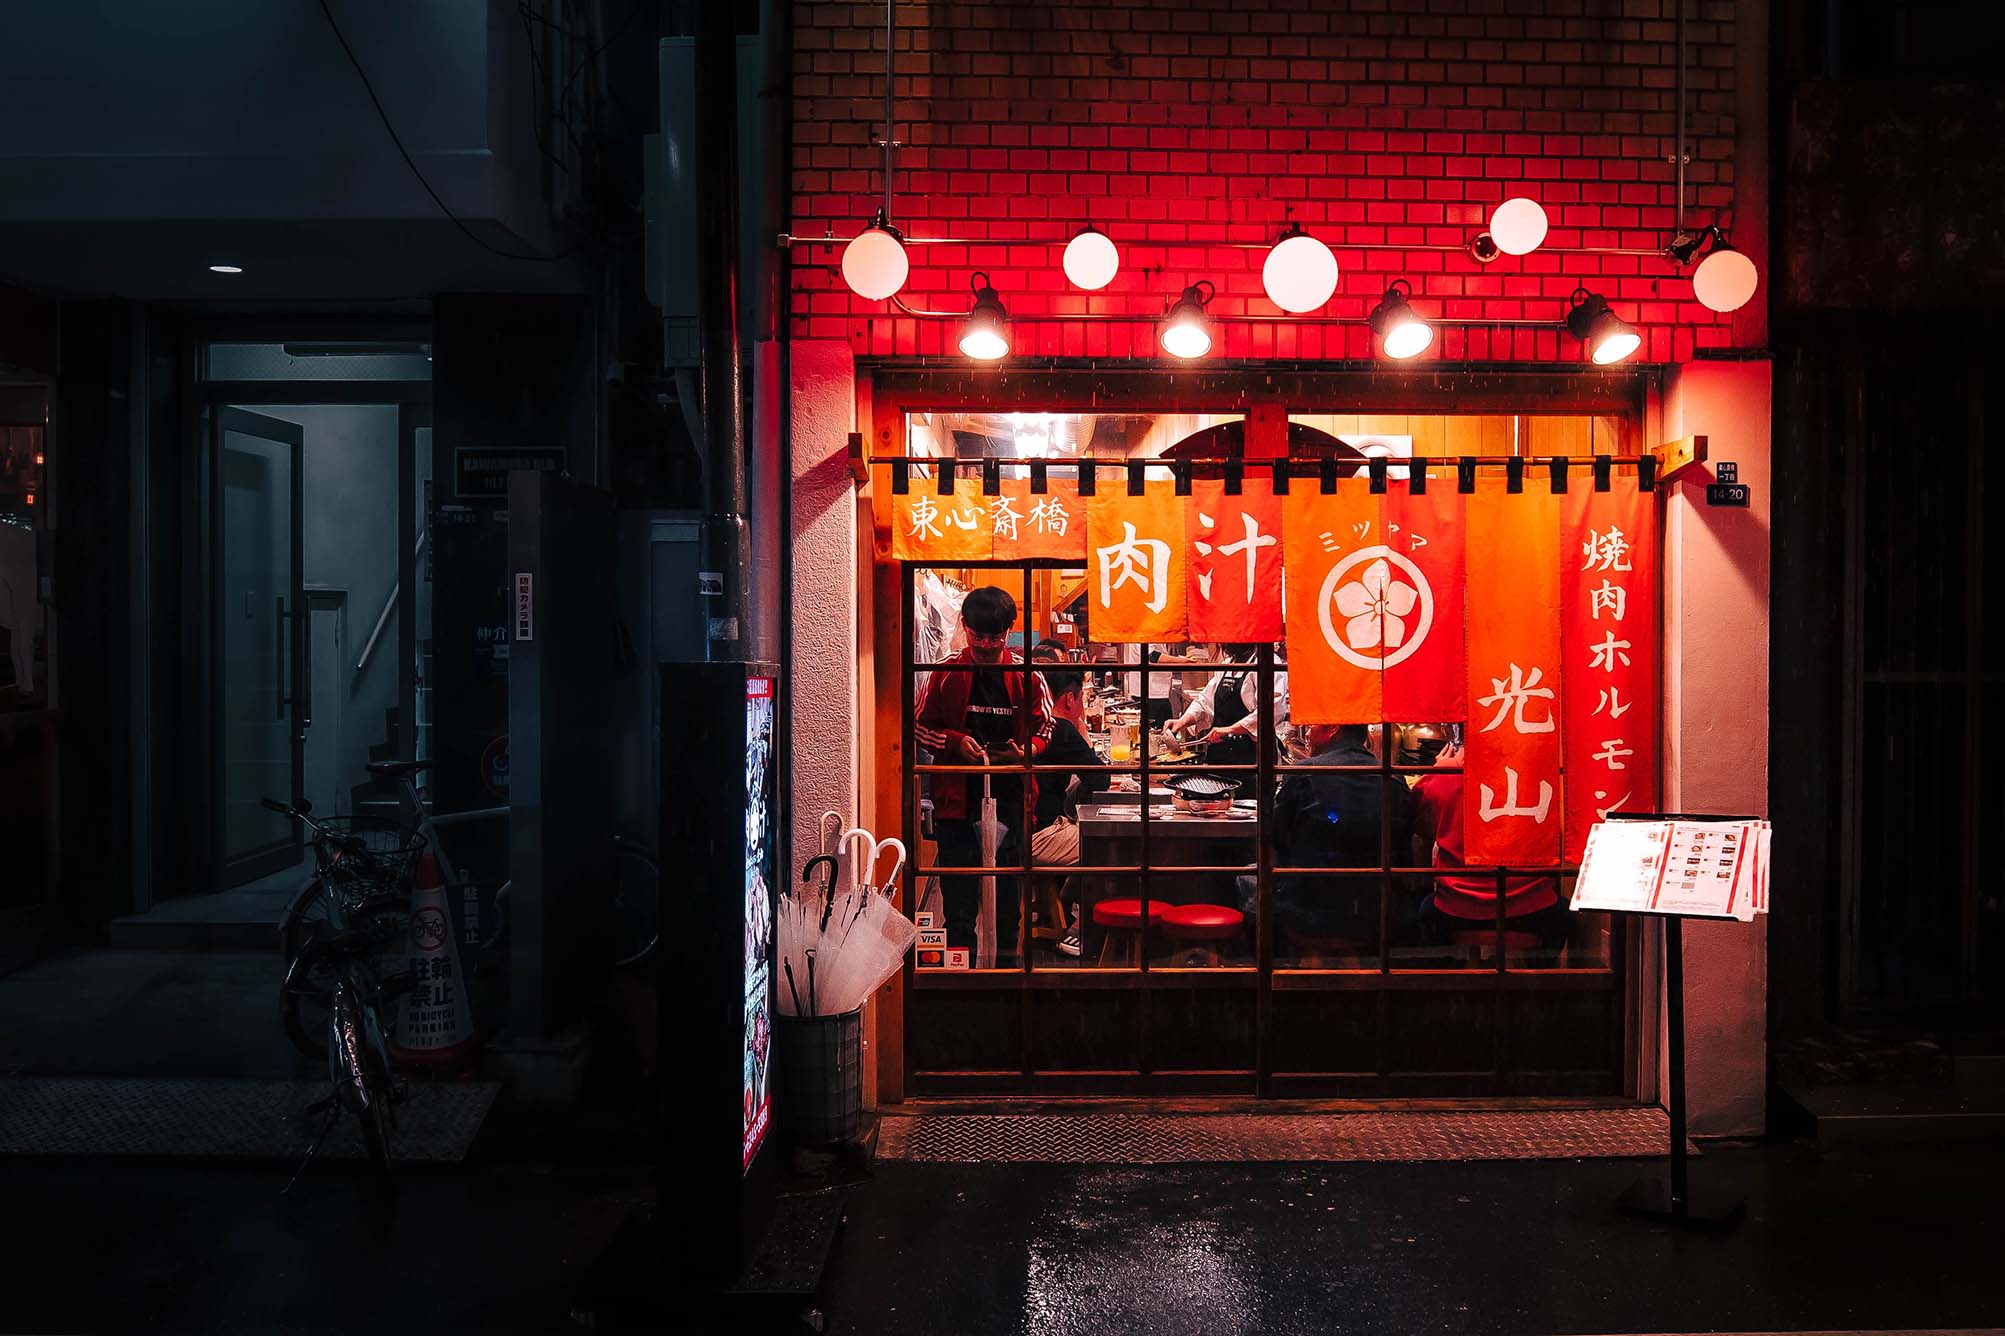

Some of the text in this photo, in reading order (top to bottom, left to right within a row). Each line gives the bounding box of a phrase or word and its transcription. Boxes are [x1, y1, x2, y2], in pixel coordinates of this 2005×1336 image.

[906, 495, 1071, 542] 東心斎橋
[1318, 520, 1428, 553] ミツヤマ
[1094, 511, 1278, 615] 肉汁
[1581, 524, 1634, 820] 焼肉ホルモン
[1476, 662, 1556, 824] 光山
[920, 935, 942, 943] VISA
